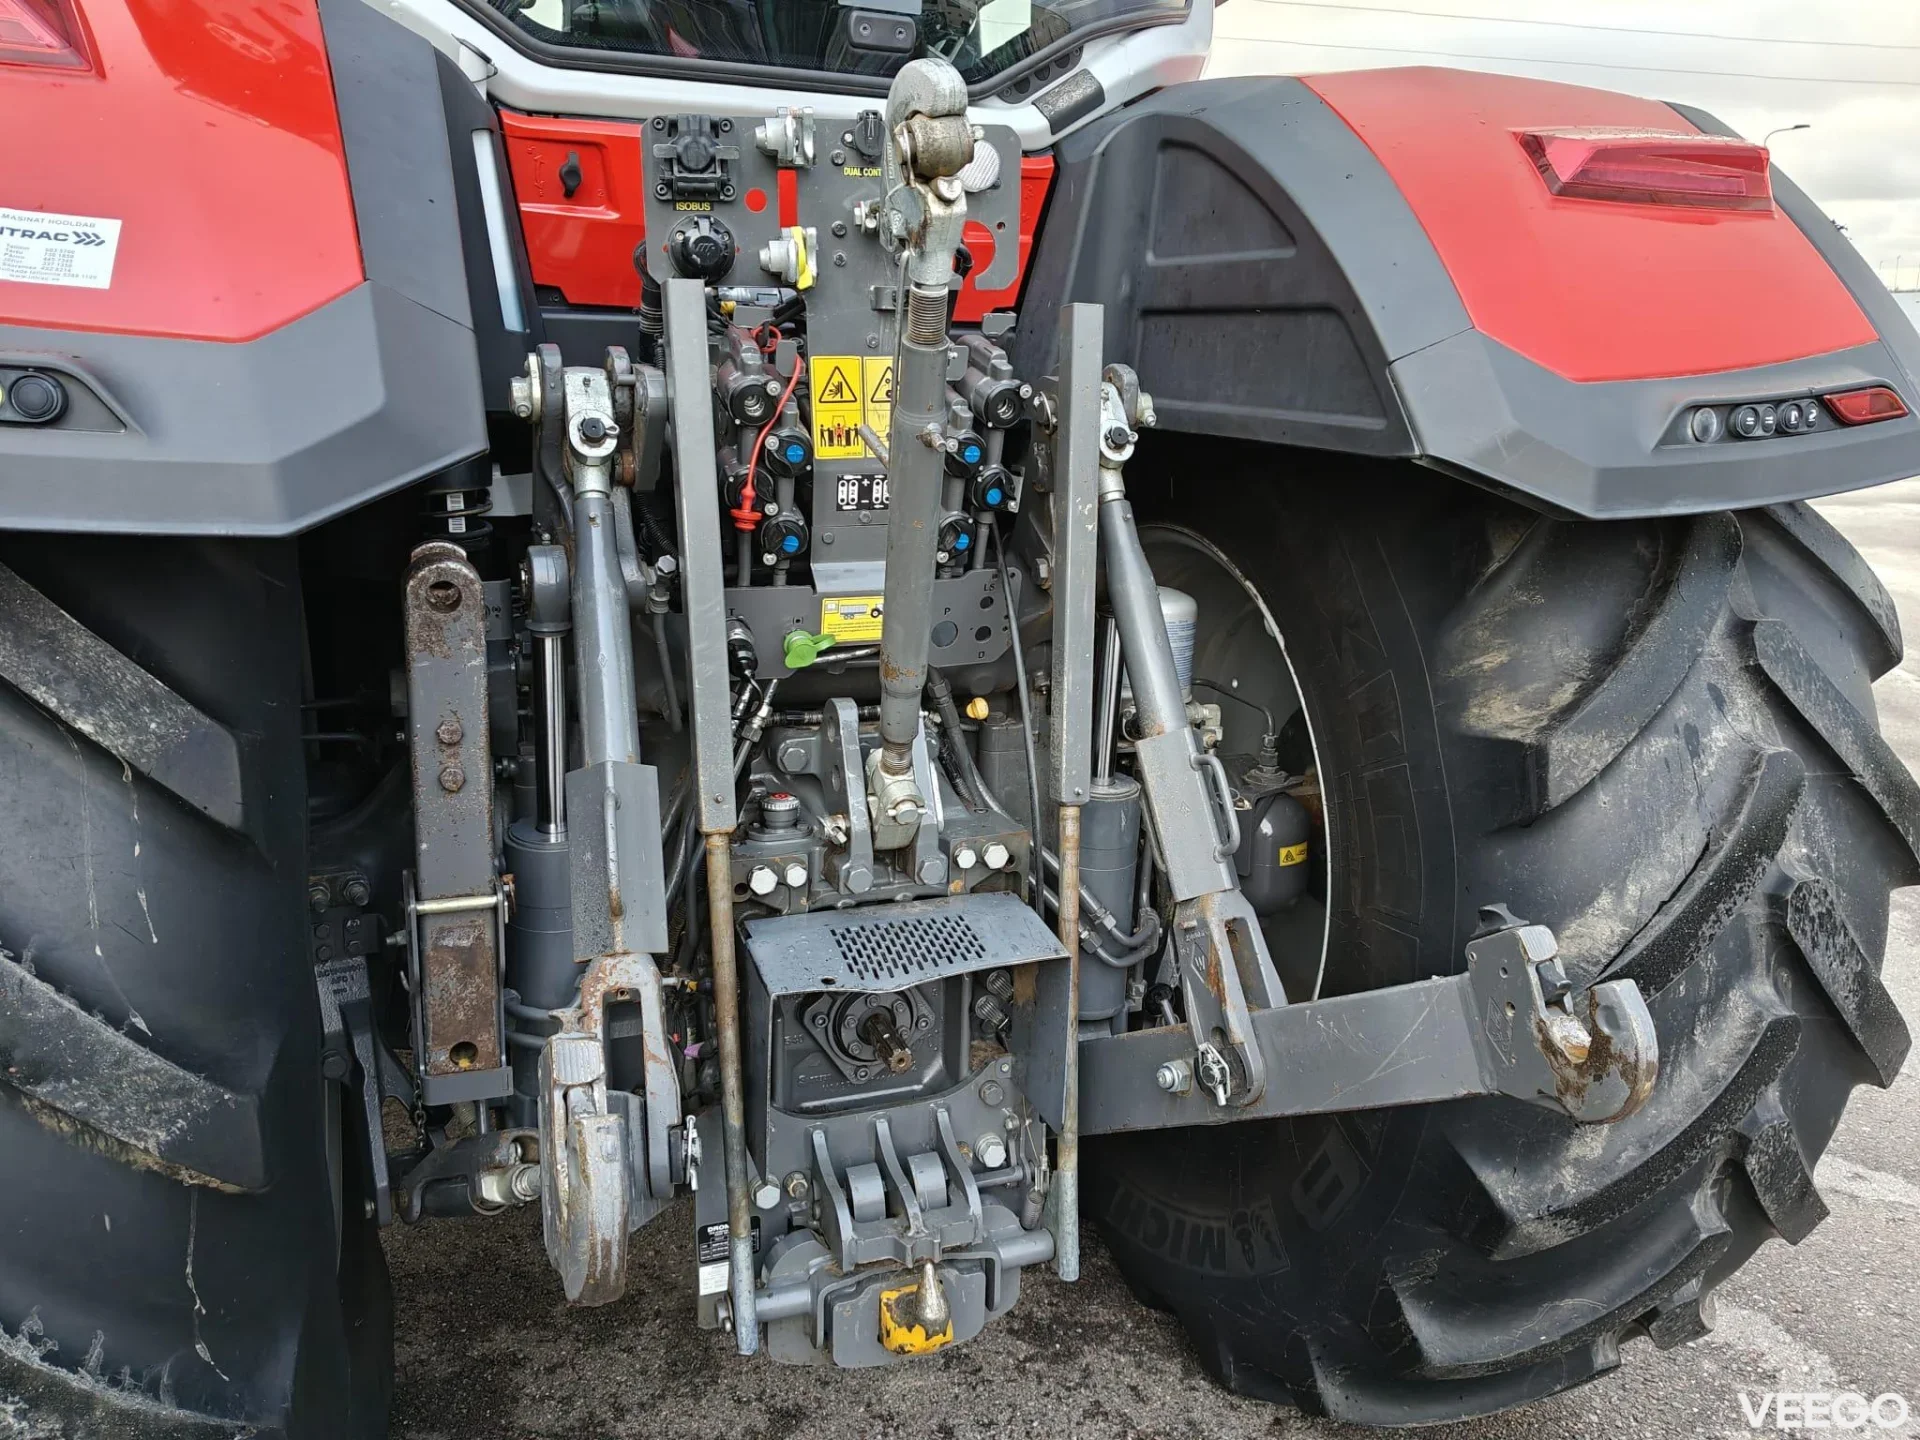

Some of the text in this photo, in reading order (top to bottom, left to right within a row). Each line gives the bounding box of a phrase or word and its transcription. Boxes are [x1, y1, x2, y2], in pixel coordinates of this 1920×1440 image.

[843, 167, 861, 176] DUAL
[675, 202, 711, 211] ISOBUS
[1, 213, 96, 229] MASINAT HOOLDAB
[983, 583, 996, 592] LS
[943, 607, 951, 615] P
